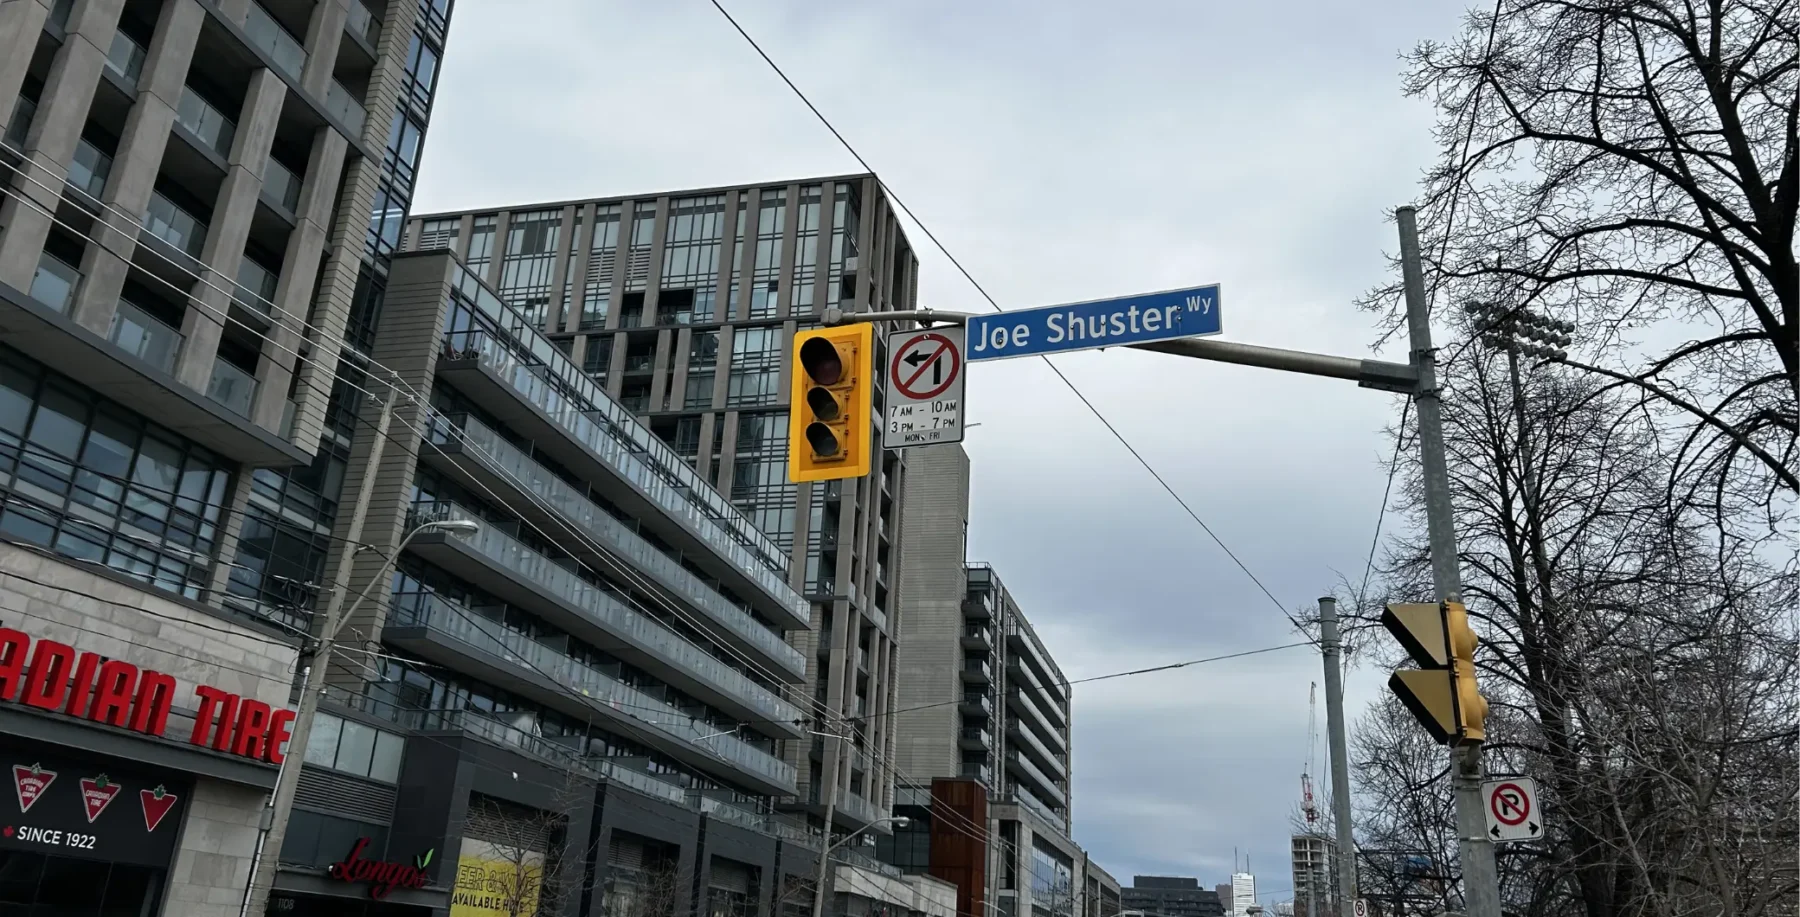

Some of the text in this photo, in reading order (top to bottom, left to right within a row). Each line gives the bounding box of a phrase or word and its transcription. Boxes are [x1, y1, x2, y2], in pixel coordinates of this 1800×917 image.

[974, 296, 1212, 352] Joe Shuster Wy
[891, 405, 898, 417] 7
[900, 406, 912, 416] AM
[931, 401, 942, 413] 10
[944, 402, 956, 412] AM
[891, 421, 898, 433] 3
[901, 423, 913, 432] PM
[932, 417, 939, 429] 7
[942, 418, 955, 428] PM
[904, 431, 940, 442] MON FRI
[190, 684, 296, 764] TIRE
[85, 789, 110, 800] CANADIAN
[90, 798, 102, 807] TIRE
[17, 825, 96, 849] SINCE 1922
[278, 897, 295, 910] 1108
[451, 892, 500, 909] AVAILABLE
